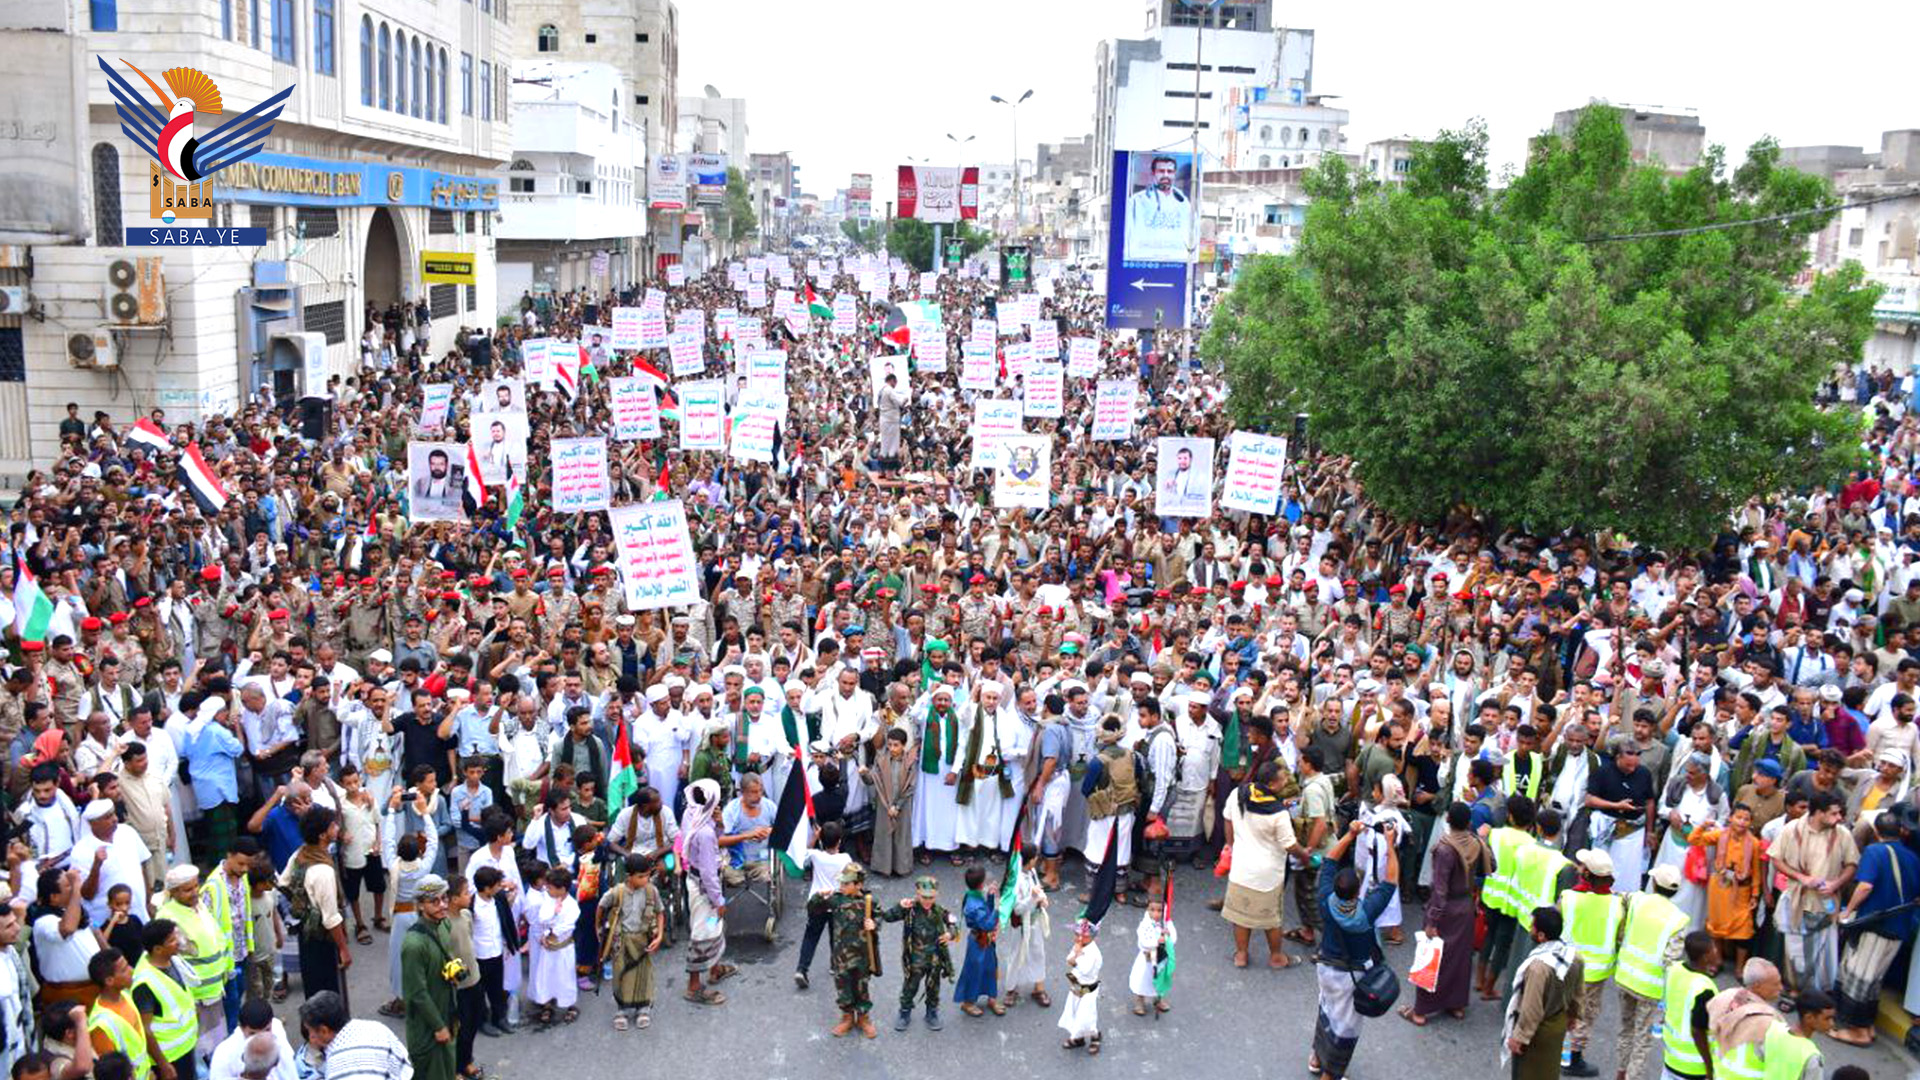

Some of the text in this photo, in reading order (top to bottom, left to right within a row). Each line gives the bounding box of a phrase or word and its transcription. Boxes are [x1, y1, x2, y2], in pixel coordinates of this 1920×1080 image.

[261, 165, 332, 196] COMMERCIAL
[338, 172, 361, 197] BANK
[622, 512, 678, 537] الله أكبر
[635, 578, 691, 600] النصر للإسلام
